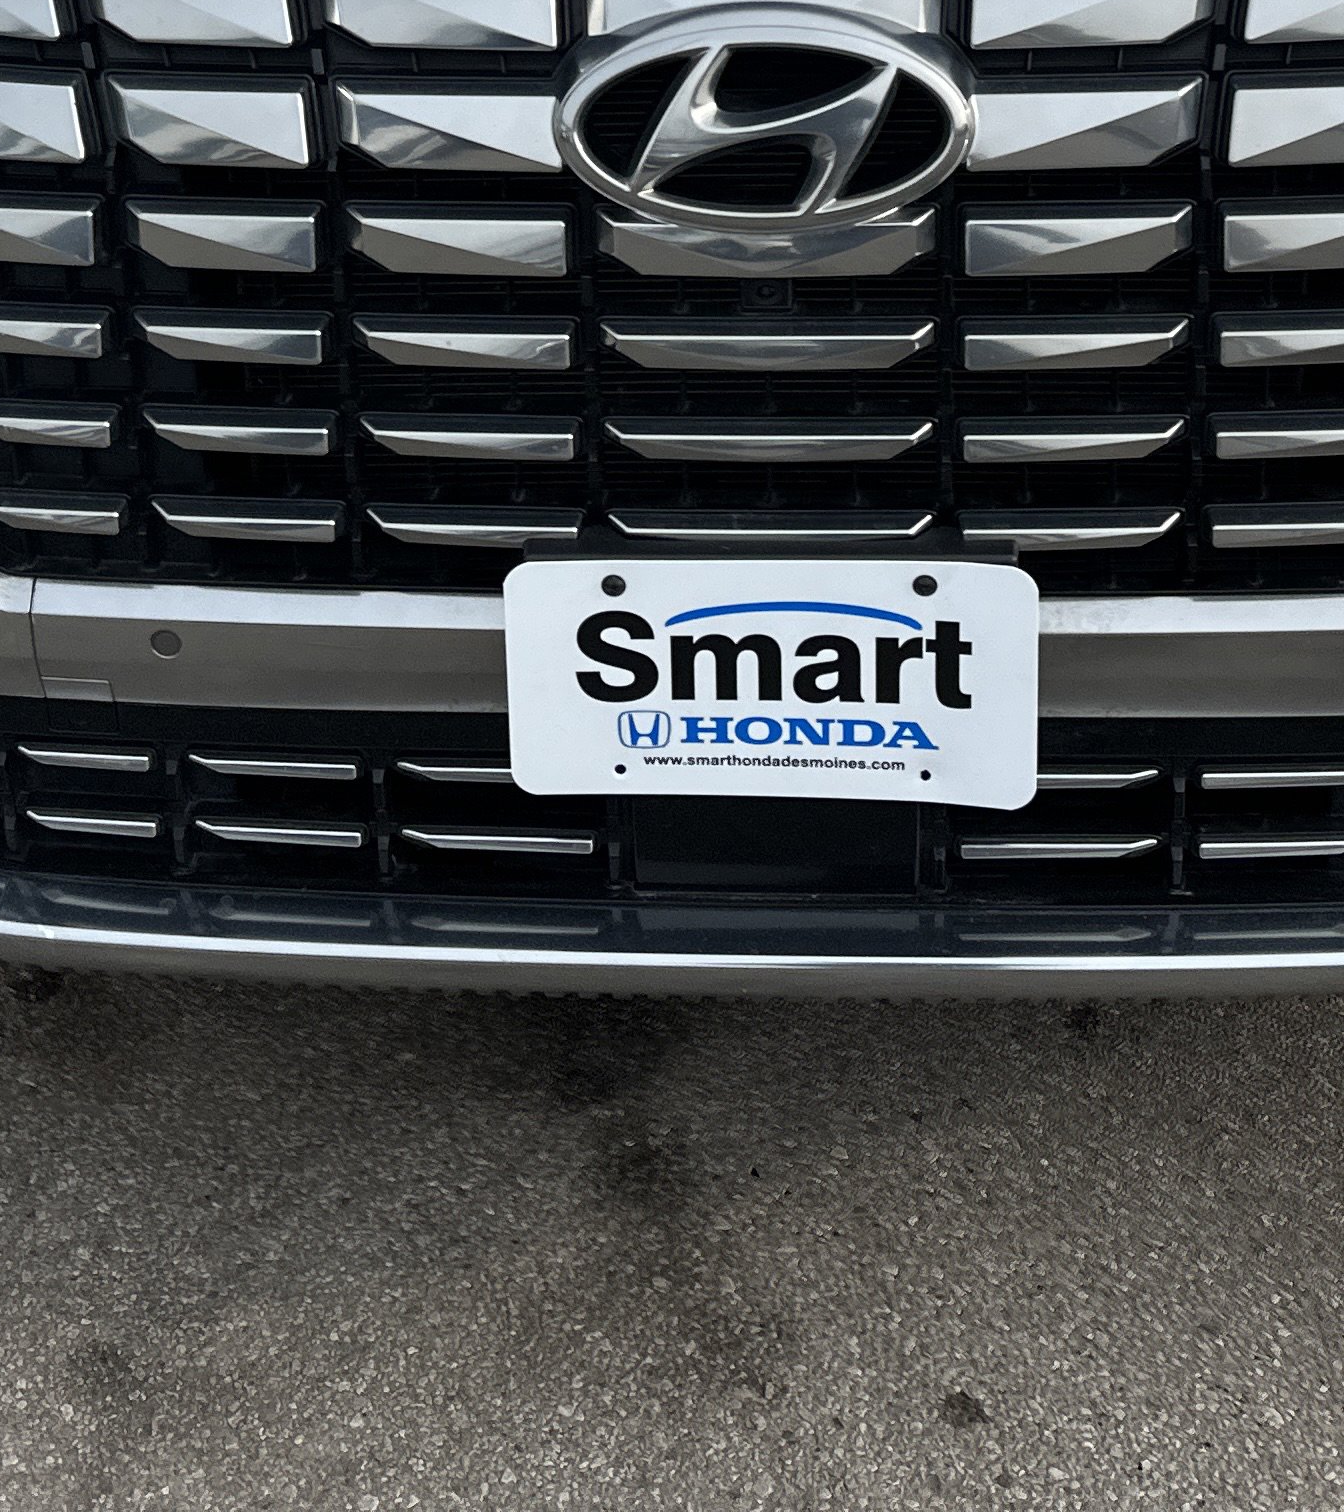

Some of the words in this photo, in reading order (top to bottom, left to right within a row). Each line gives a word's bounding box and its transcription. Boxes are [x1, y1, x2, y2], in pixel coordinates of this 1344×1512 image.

[575, 610, 973, 709] Smart
[680, 716, 940, 750] HONDA
[644, 755, 905, 771] www.smarthondadesmoines.com
